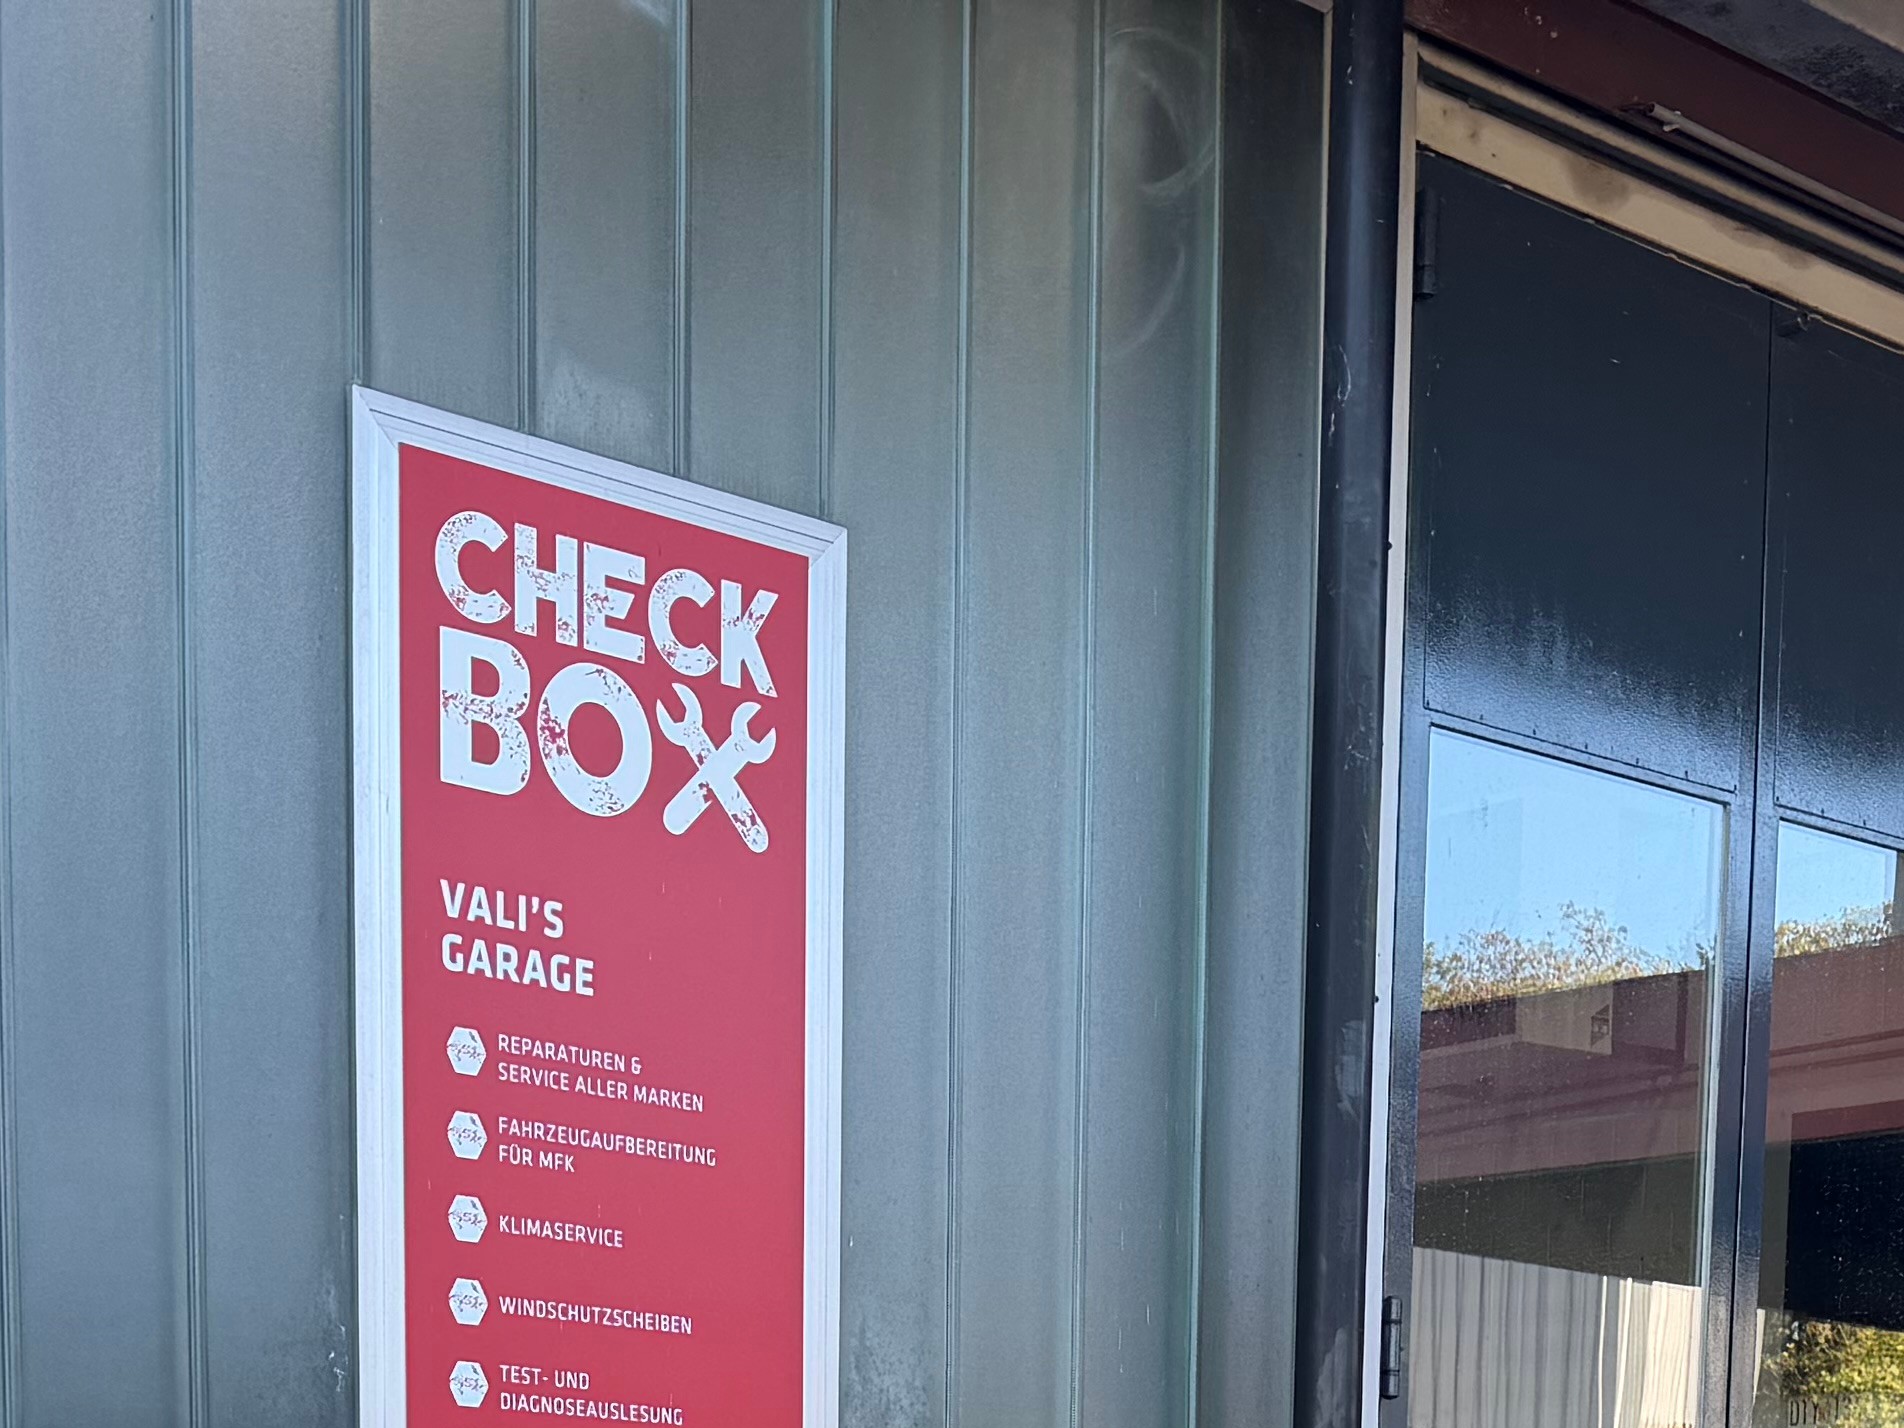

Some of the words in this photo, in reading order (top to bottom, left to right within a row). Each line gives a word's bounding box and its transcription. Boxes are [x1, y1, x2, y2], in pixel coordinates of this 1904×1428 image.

[434, 510, 779, 698] CHECK
[439, 625, 777, 853] BOX
[439, 878, 564, 938] VALI'S
[441, 933, 594, 997] GARAGE
[498, 1033, 625, 1073] REPARATUREN
[630, 1056, 642, 1075] &
[498, 1062, 570, 1092] SERVICE
[575, 1075, 628, 1101] ALLER
[633, 1085, 704, 1113] MARKEN
[498, 1116, 716, 1167] FAHRZEUGAUFBEREITUNG
[498, 1143, 533, 1167] FÜR
[539, 1151, 576, 1172] MFK
[499, 1215, 624, 1248] KLIMASERVICE
[499, 1295, 693, 1335] WINDSCHUTZSCHEIBEN
[499, 1364, 549, 1386] TEST-
[554, 1369, 590, 1391] UND
[500, 1391, 683, 1426] DIAGNOSEAUSLESUNG
